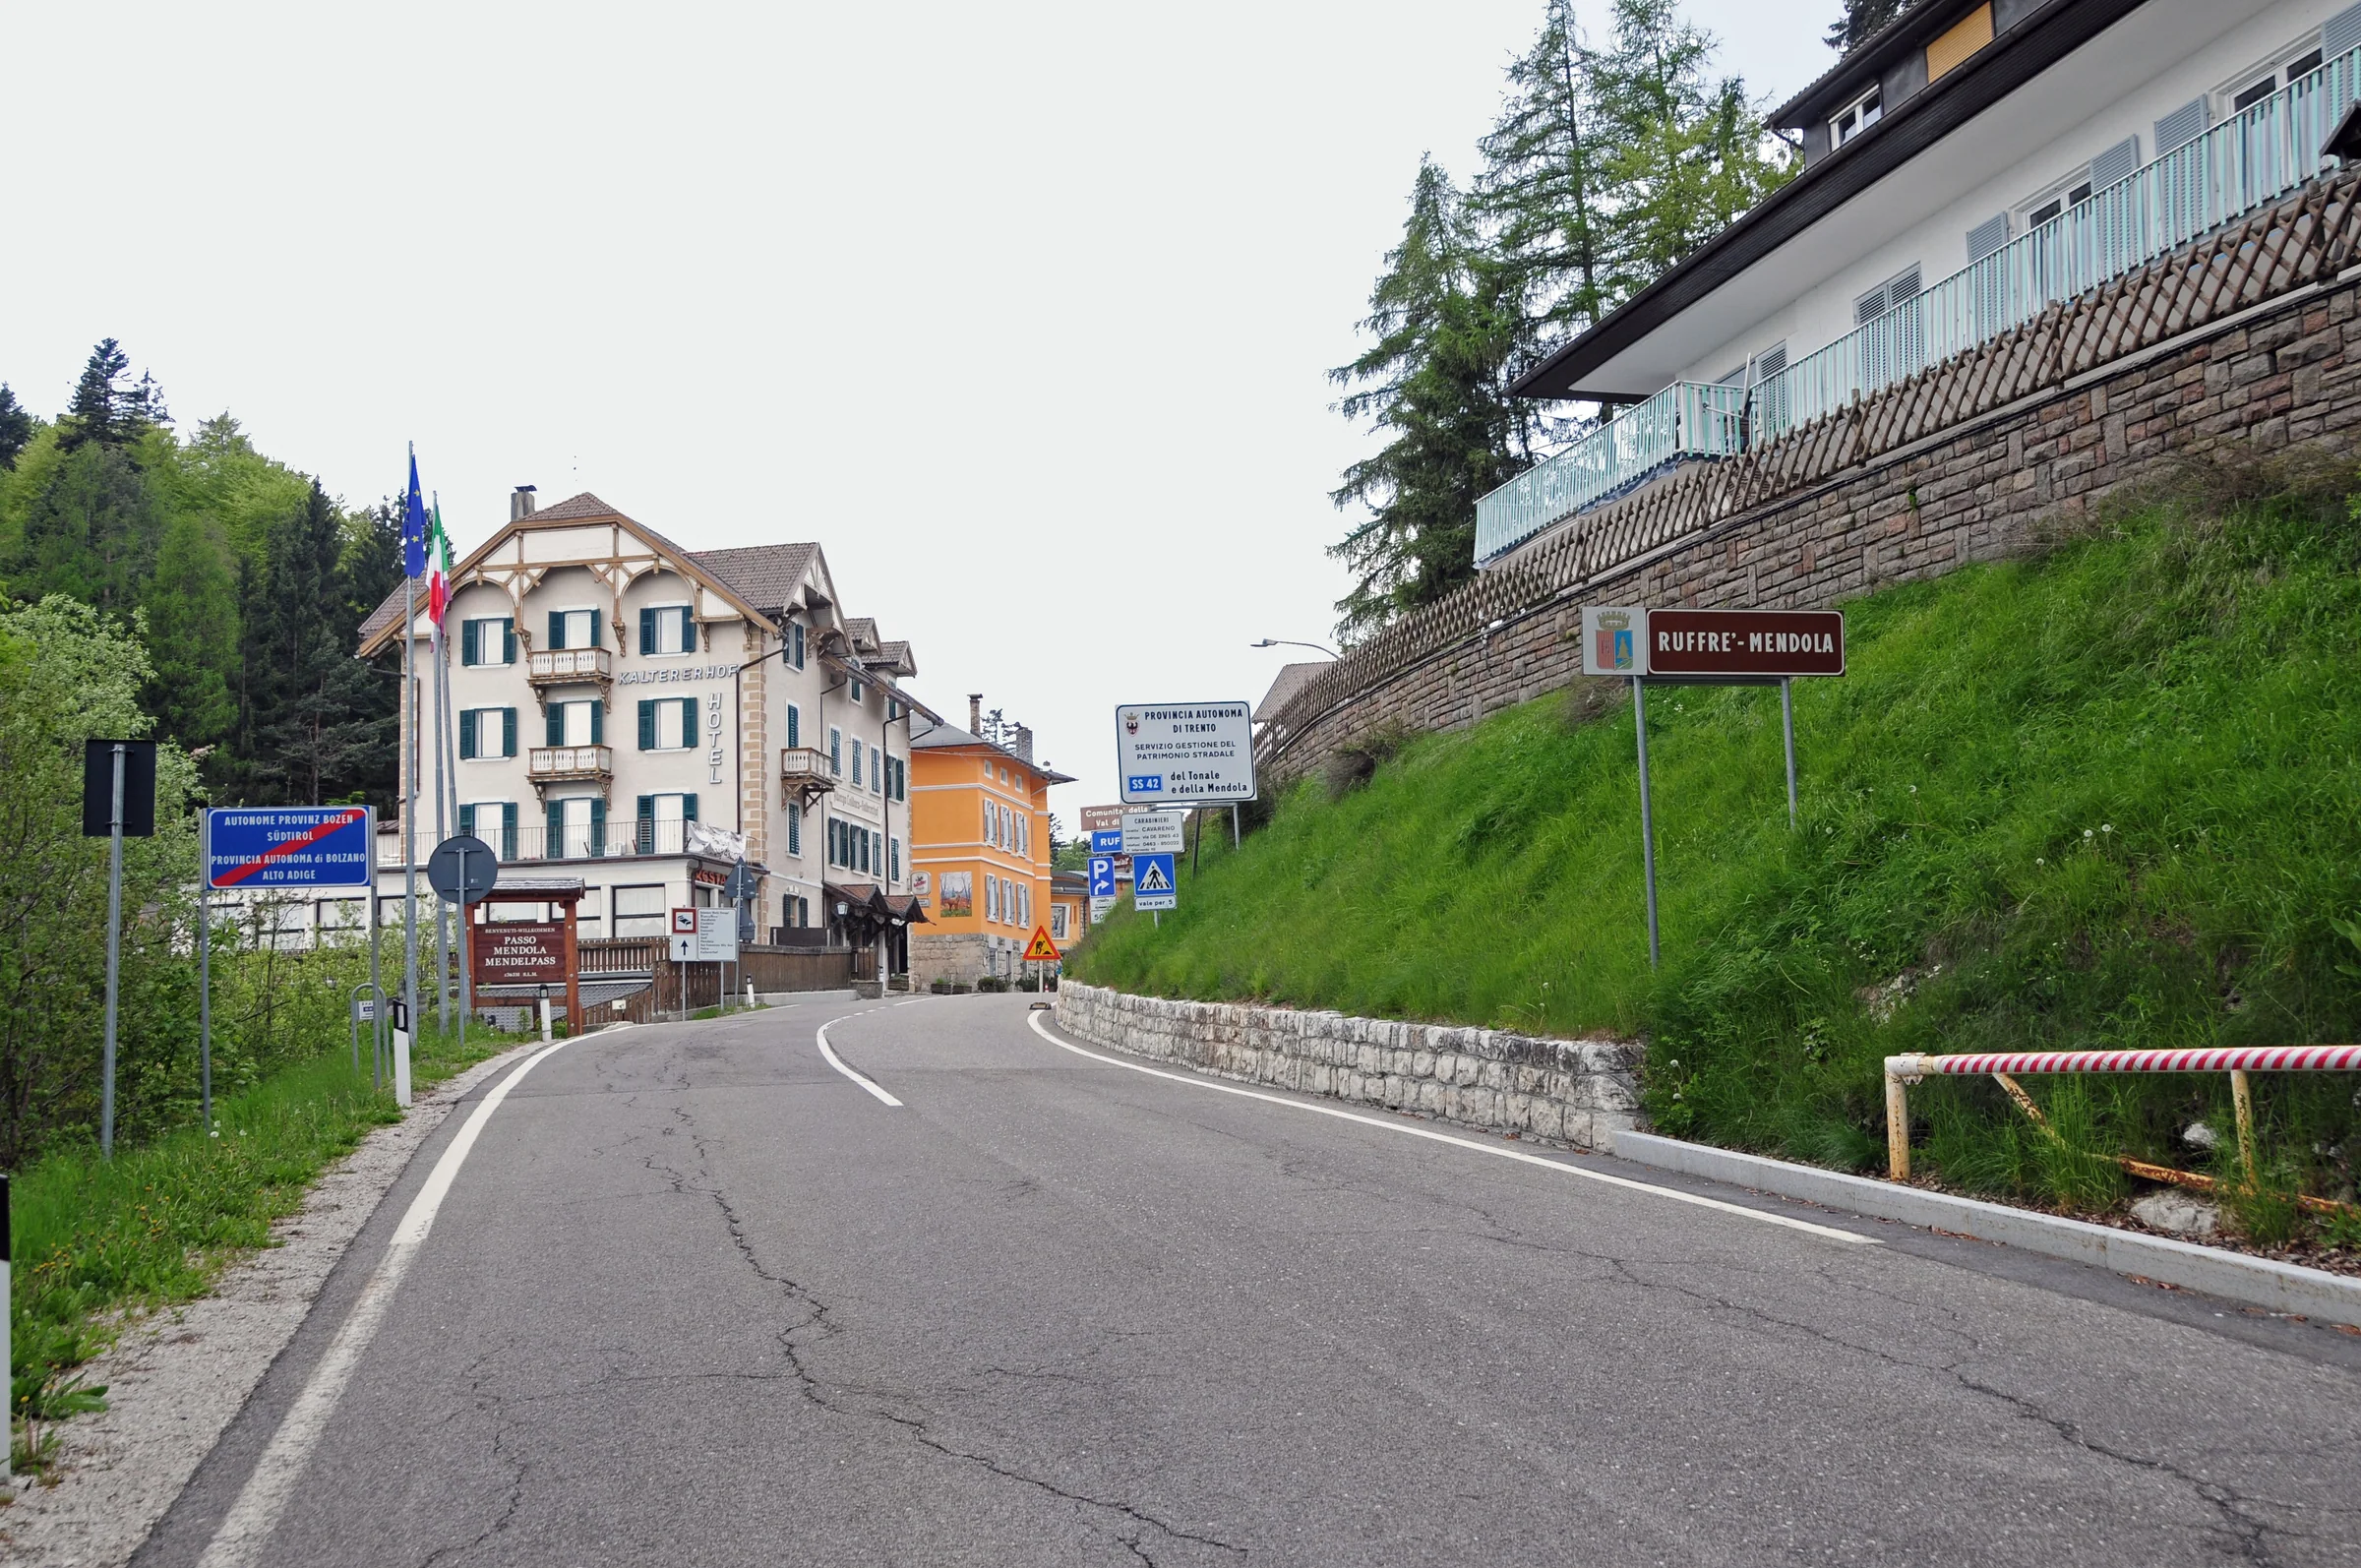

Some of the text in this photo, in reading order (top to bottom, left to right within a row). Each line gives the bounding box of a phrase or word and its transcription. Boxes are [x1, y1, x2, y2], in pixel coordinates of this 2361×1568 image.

[618, 664, 739, 686] KALTERERHOF
[1144, 709, 1242, 720] PROVINCIA AUTONOMA
[1173, 724, 1217, 733] DI TRENTO
[707, 693, 723, 785] HOTEL
[1176, 741, 1218, 750] GESTIONE
[1136, 752, 1190, 760] PATRIMONIO
[1171, 770, 1220, 781] del Tonale
[1132, 779, 1159, 789] SS 42
[1180, 784, 1204, 794] della
[1208, 783, 1247, 793] Mendola
[224, 814, 353, 826] AUTONOME PROVINZ BOZEN
[268, 830, 314, 842] SÜDTIROL
[211, 853, 366, 865] PROVINCIA AUTONOMA di BOLZANO
[1093, 860, 1109, 879] P
[263, 871, 316, 880] ALTO ADIGE
[493, 946, 547, 955] MENDOLA
[485, 956, 556, 966] MENDELPASS
